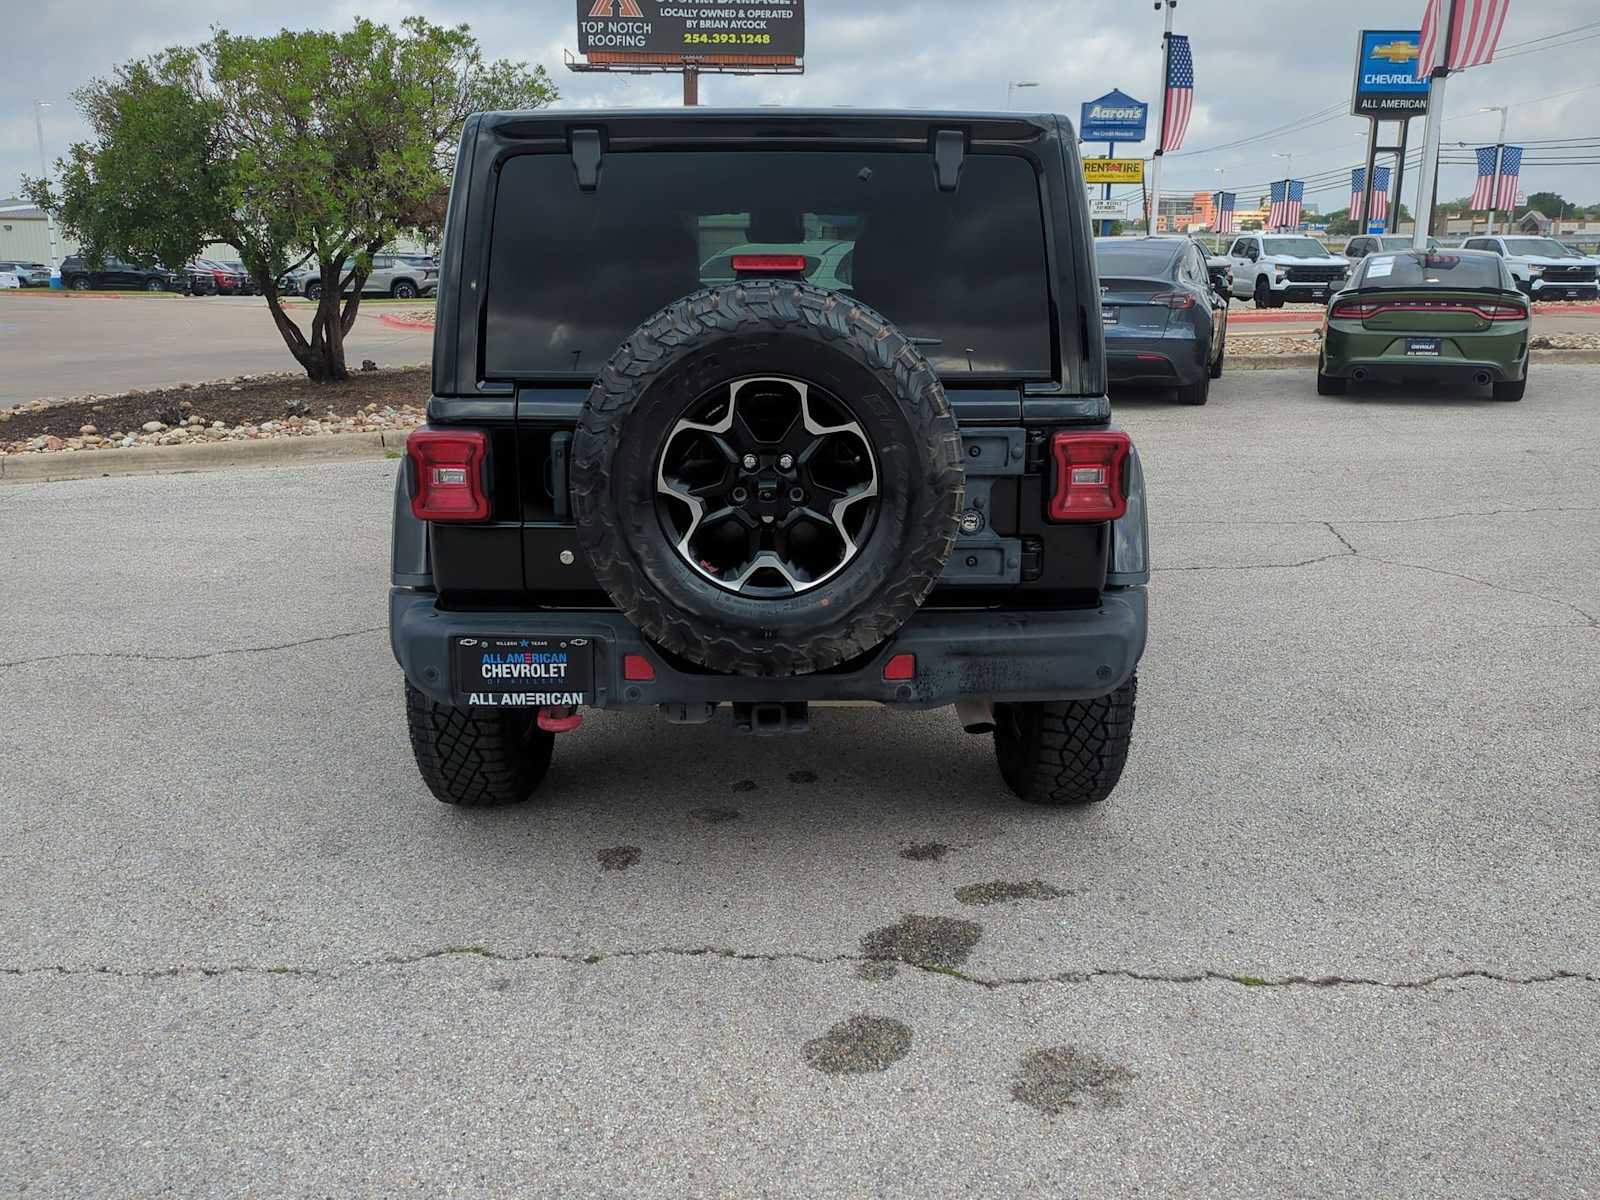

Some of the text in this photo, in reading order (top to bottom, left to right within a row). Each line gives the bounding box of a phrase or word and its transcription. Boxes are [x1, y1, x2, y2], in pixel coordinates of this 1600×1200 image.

[660, 8, 793, 18] LOCALLY OWNED & OPERATED
[581, 22, 651, 34] TOP NOTCH
[686, 20, 767, 29] BY BRIAN AYCOCK
[588, 34, 646, 46] ROOFING
[683, 33, 771, 44] 254.393.1248
[1361, 99, 1426, 109] ALL AMERICAN
[1090, 106, 1143, 119] Aaron's
[482, 652, 567, 664] ALL AMERICAN
[481, 663, 567, 678] CHEVROLET
[468, 692, 583, 705] ALL AMERICAN
